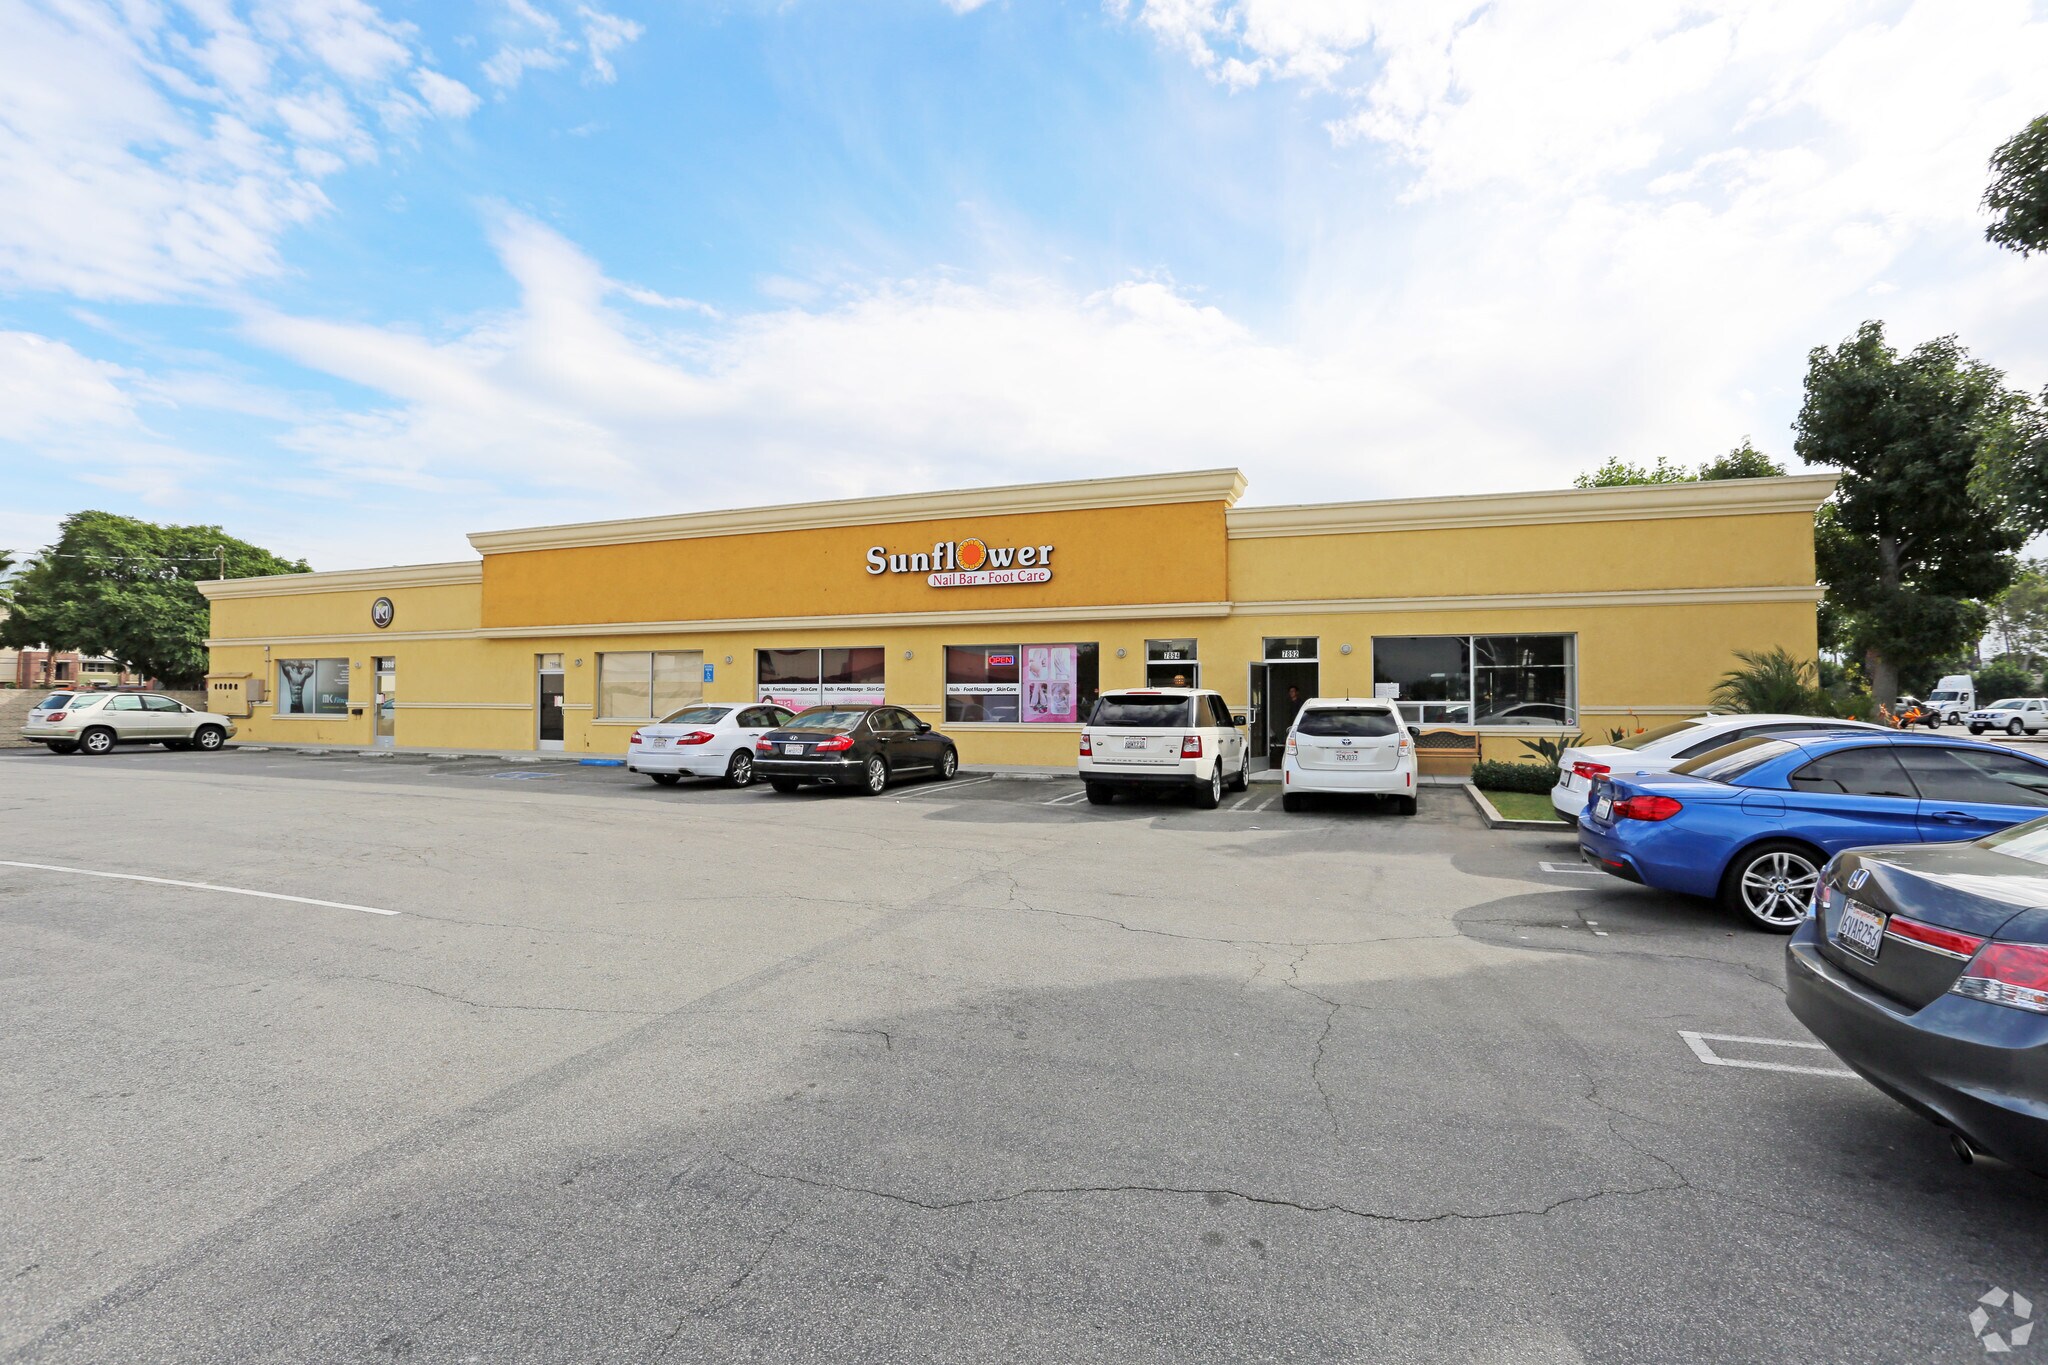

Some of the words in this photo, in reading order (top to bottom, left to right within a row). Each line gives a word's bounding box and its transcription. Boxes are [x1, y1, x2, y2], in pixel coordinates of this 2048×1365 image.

[866, 537, 1053, 575] Sunflower
[933, 574, 956, 586] Nail
[959, 572, 978, 585] Bar
[988, 571, 1015, 584] Foot
[1017, 570, 1045, 582] Care
[988, 656, 1012, 664] OPEN
[1163, 652, 1180, 660] 7894
[1281, 650, 1299, 658] 7892
[1841, 915, 1881, 948] 6VAR256
